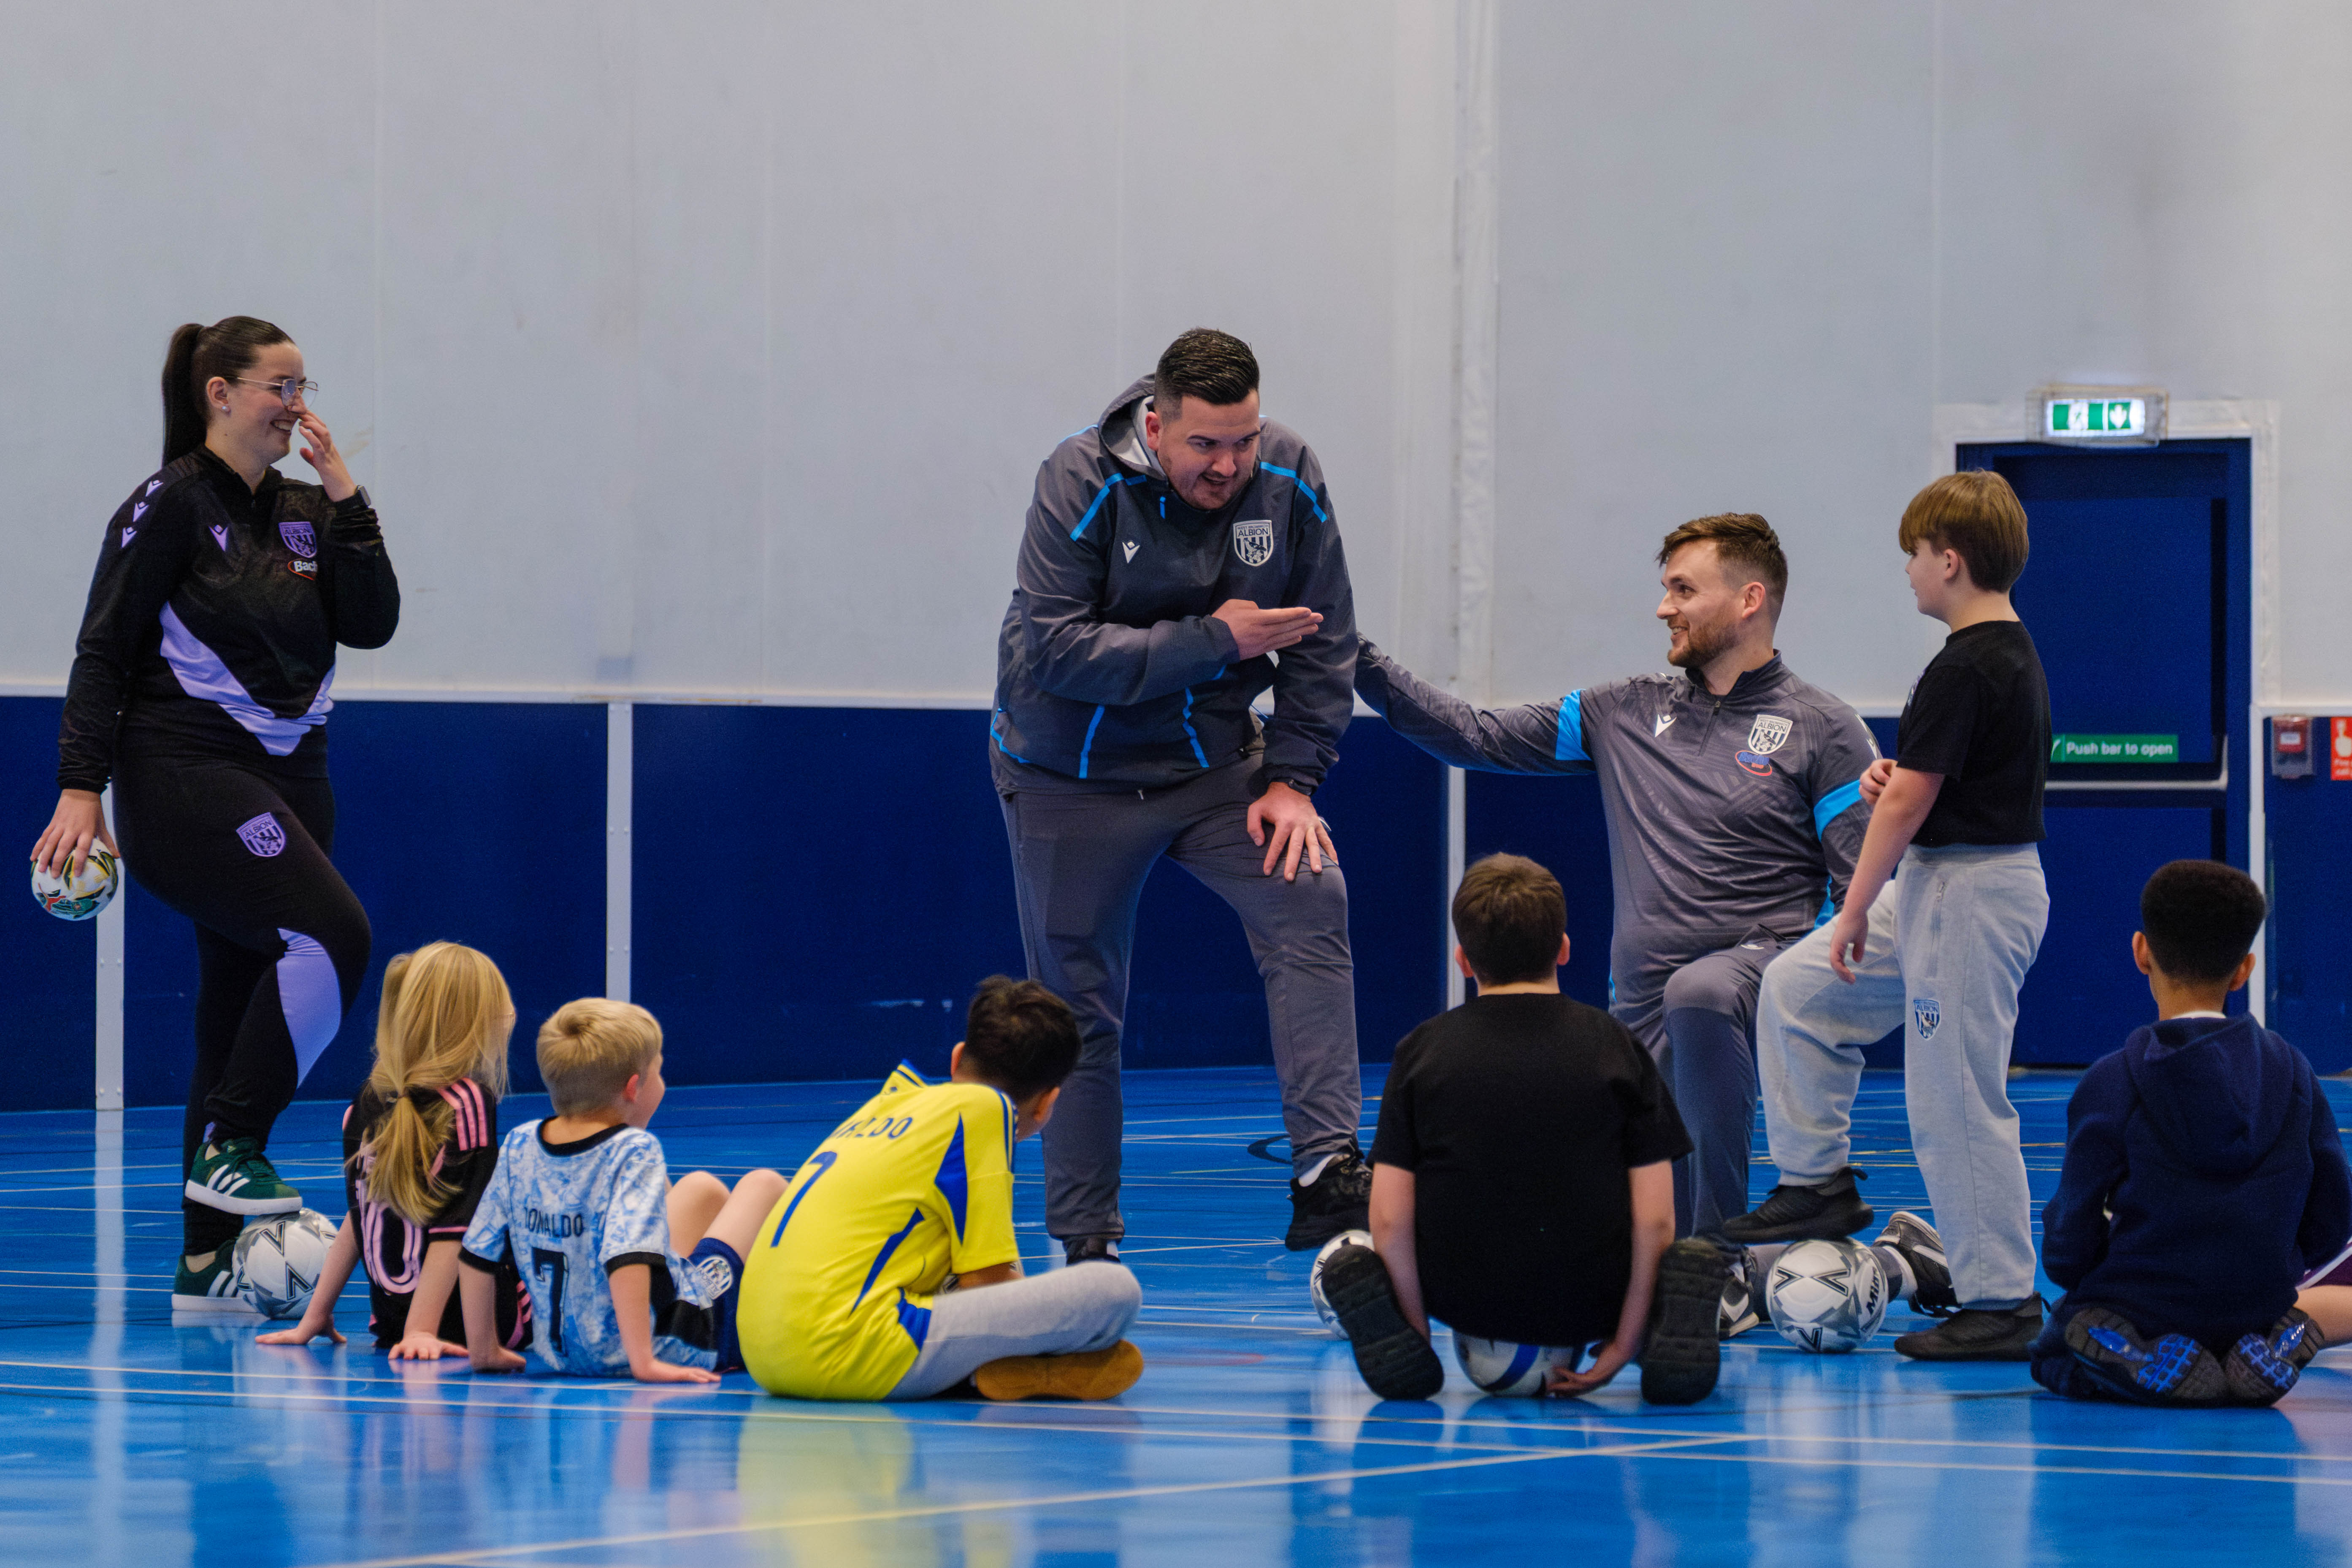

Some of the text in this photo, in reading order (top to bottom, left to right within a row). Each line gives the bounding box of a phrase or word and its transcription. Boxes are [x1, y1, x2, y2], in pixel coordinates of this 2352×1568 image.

[1238, 528, 1269, 537] ALBION
[1757, 722, 1786, 732] ALBION
[2066, 741, 2173, 757] Push bar to open
[245, 820, 272, 839] ALBION
[1916, 1005, 1938, 1013] ALBION
[770, 1151, 837, 1248] 7
[532, 1246, 569, 1357] 7
